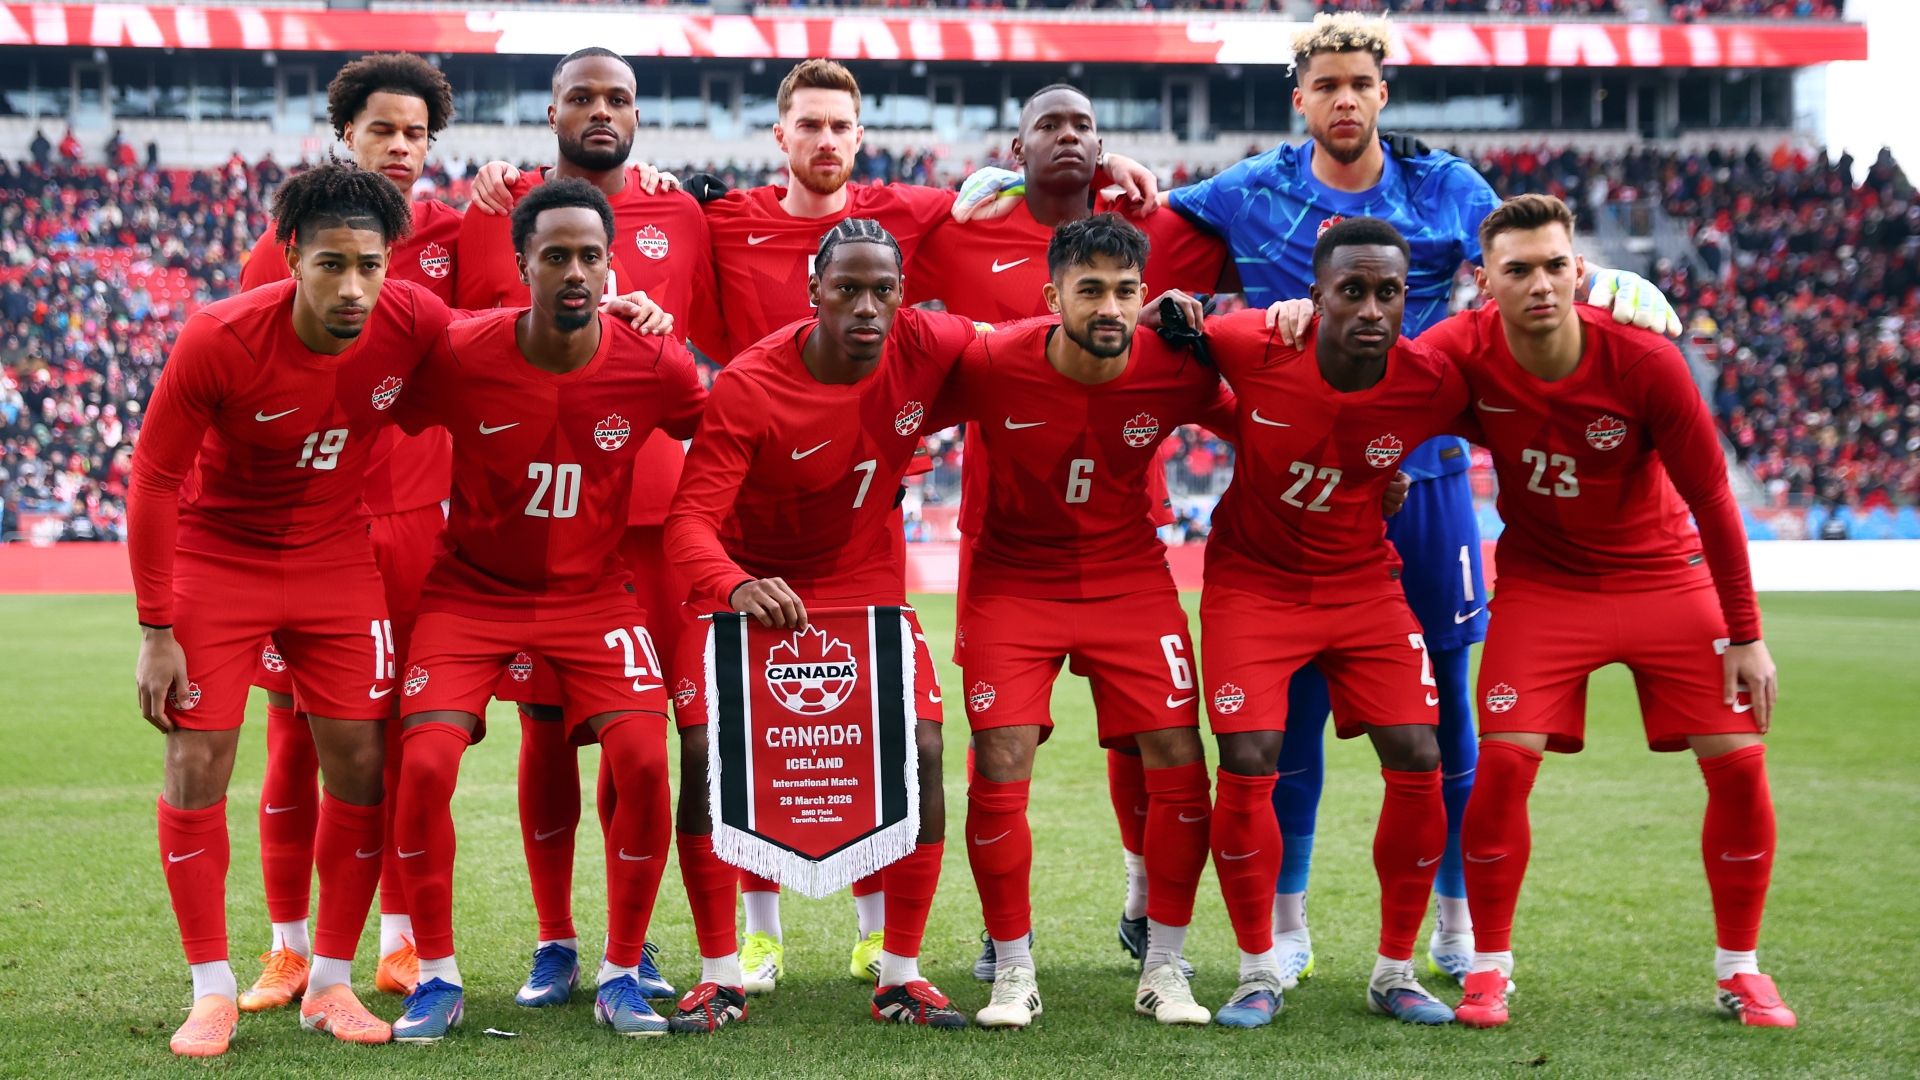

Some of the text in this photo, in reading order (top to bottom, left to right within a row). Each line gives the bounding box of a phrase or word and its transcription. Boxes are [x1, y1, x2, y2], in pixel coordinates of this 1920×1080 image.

[421, 258, 449, 267] CANADA
[372, 387, 401, 402] CANADA
[895, 410, 923, 428] CANADA
[1588, 429, 1626, 438] CANADA
[296, 428, 349, 470] 19
[852, 459, 877, 509] 7
[1066, 458, 1095, 503] 6
[1520, 448, 1580, 498] 23
[525, 462, 582, 518] 20
[1280, 461, 1342, 512] 22
[1459, 545, 1475, 601] 1
[370, 619, 396, 680] 19
[604, 625, 664, 680] 20
[767, 665, 854, 680] CANADA
[1160, 634, 1193, 690] 6
[404, 677, 427, 688] CANADA
[969, 693, 994, 702] CANADA
[765, 724, 862, 748] CANADA
[786, 757, 844, 770] ICELAND
[772, 777, 859, 788] International Match
[780, 795, 852, 806] 28 March 2026
